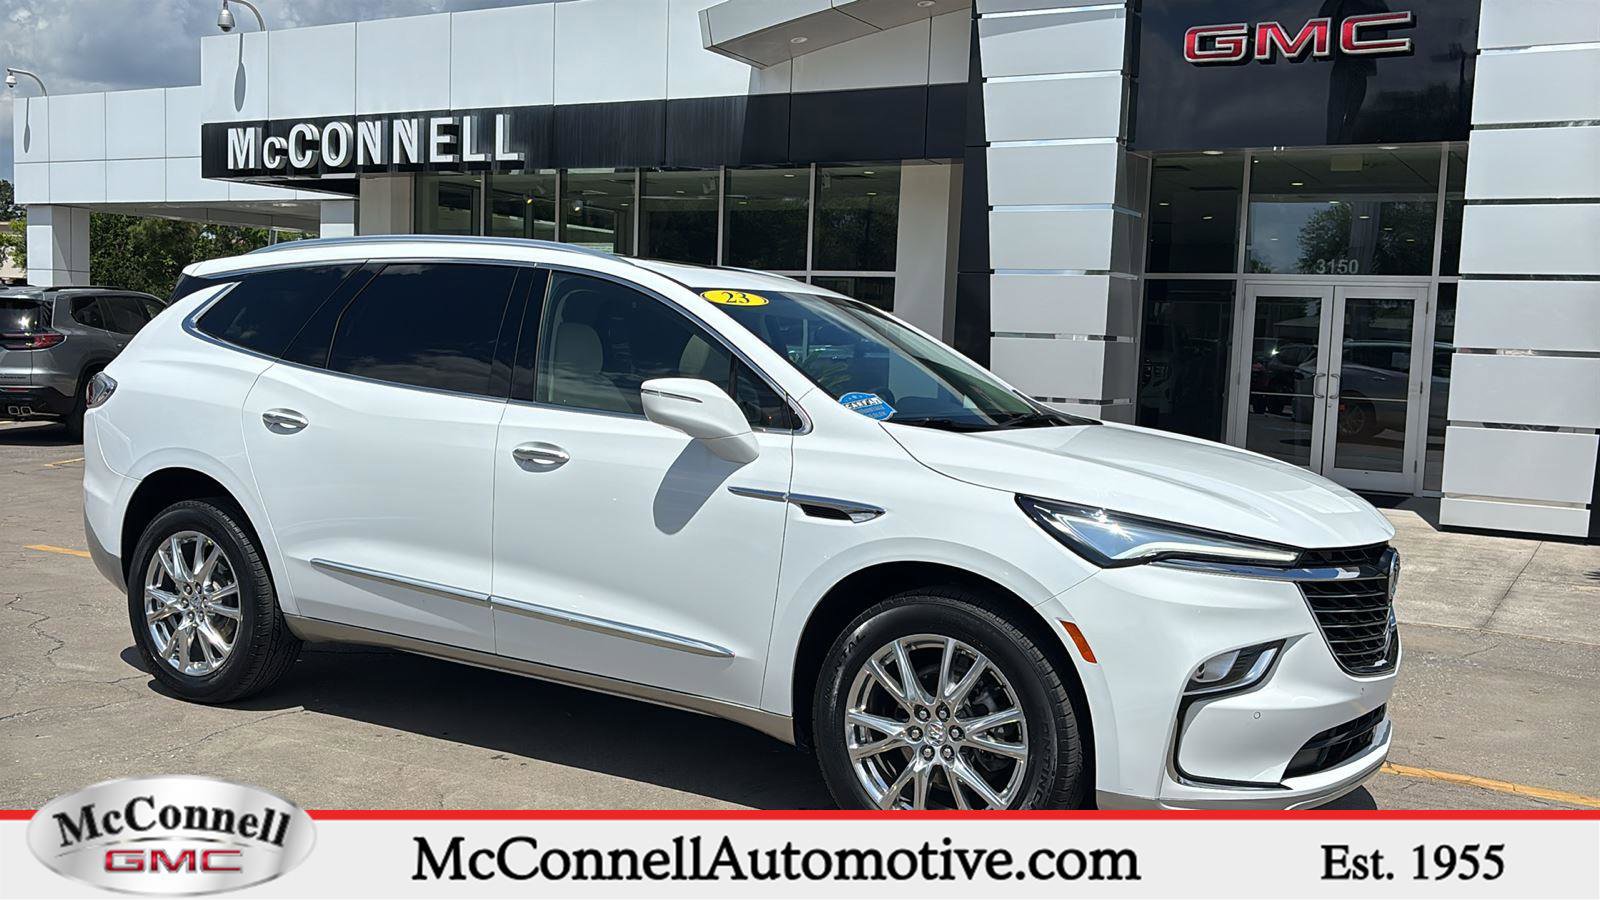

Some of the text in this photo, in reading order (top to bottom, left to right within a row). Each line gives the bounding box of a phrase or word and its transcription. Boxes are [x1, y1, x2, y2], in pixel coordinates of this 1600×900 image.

[1184, 10, 1411, 63] GMC
[1316, 258, 1359, 274] 3150
[721, 291, 750, 304] 23
